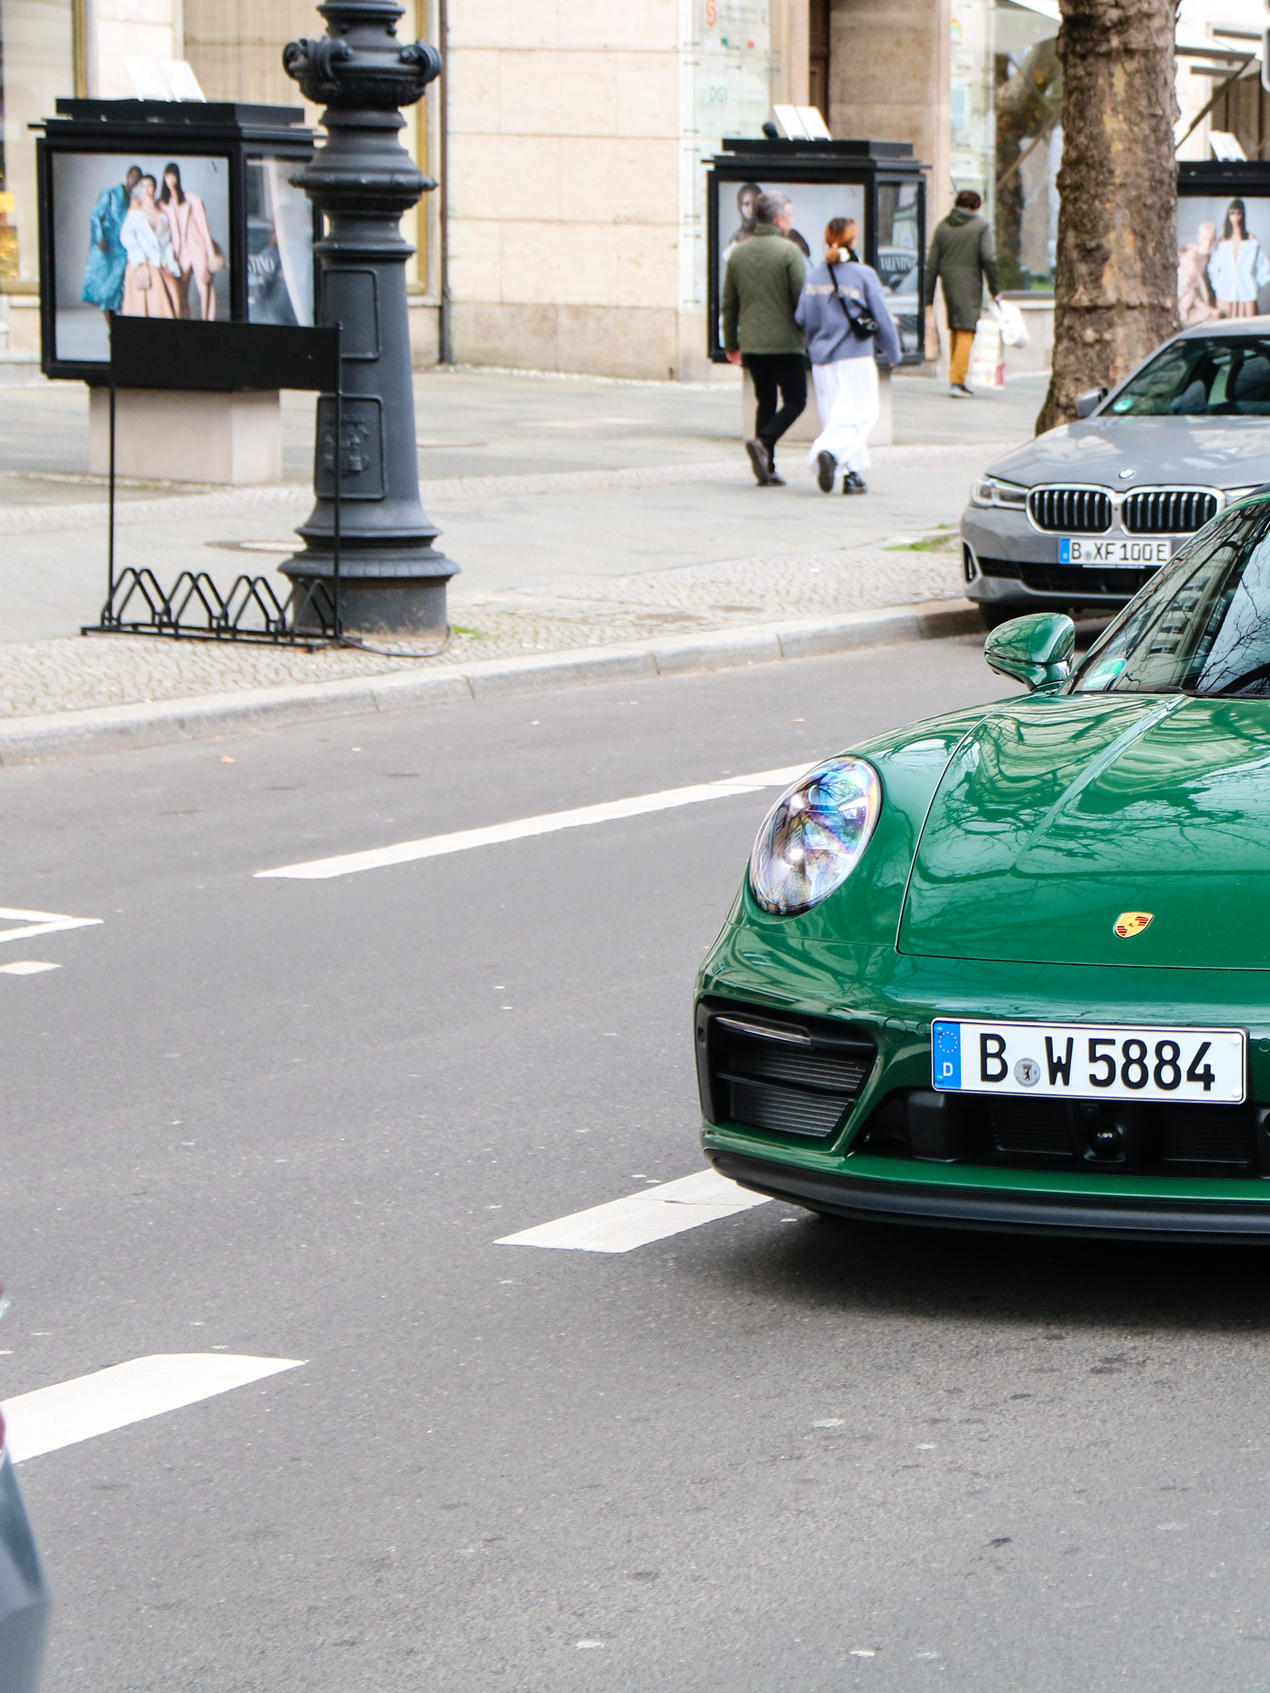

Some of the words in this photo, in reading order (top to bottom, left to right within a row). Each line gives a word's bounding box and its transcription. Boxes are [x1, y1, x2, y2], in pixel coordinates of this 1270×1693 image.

[1071, 542, 1082, 560] B
[943, 1062, 953, 1076] D
[979, 1033, 1008, 1082] B
[1044, 1036, 1074, 1086] W
[1088, 1038, 1215, 1091] 5884
